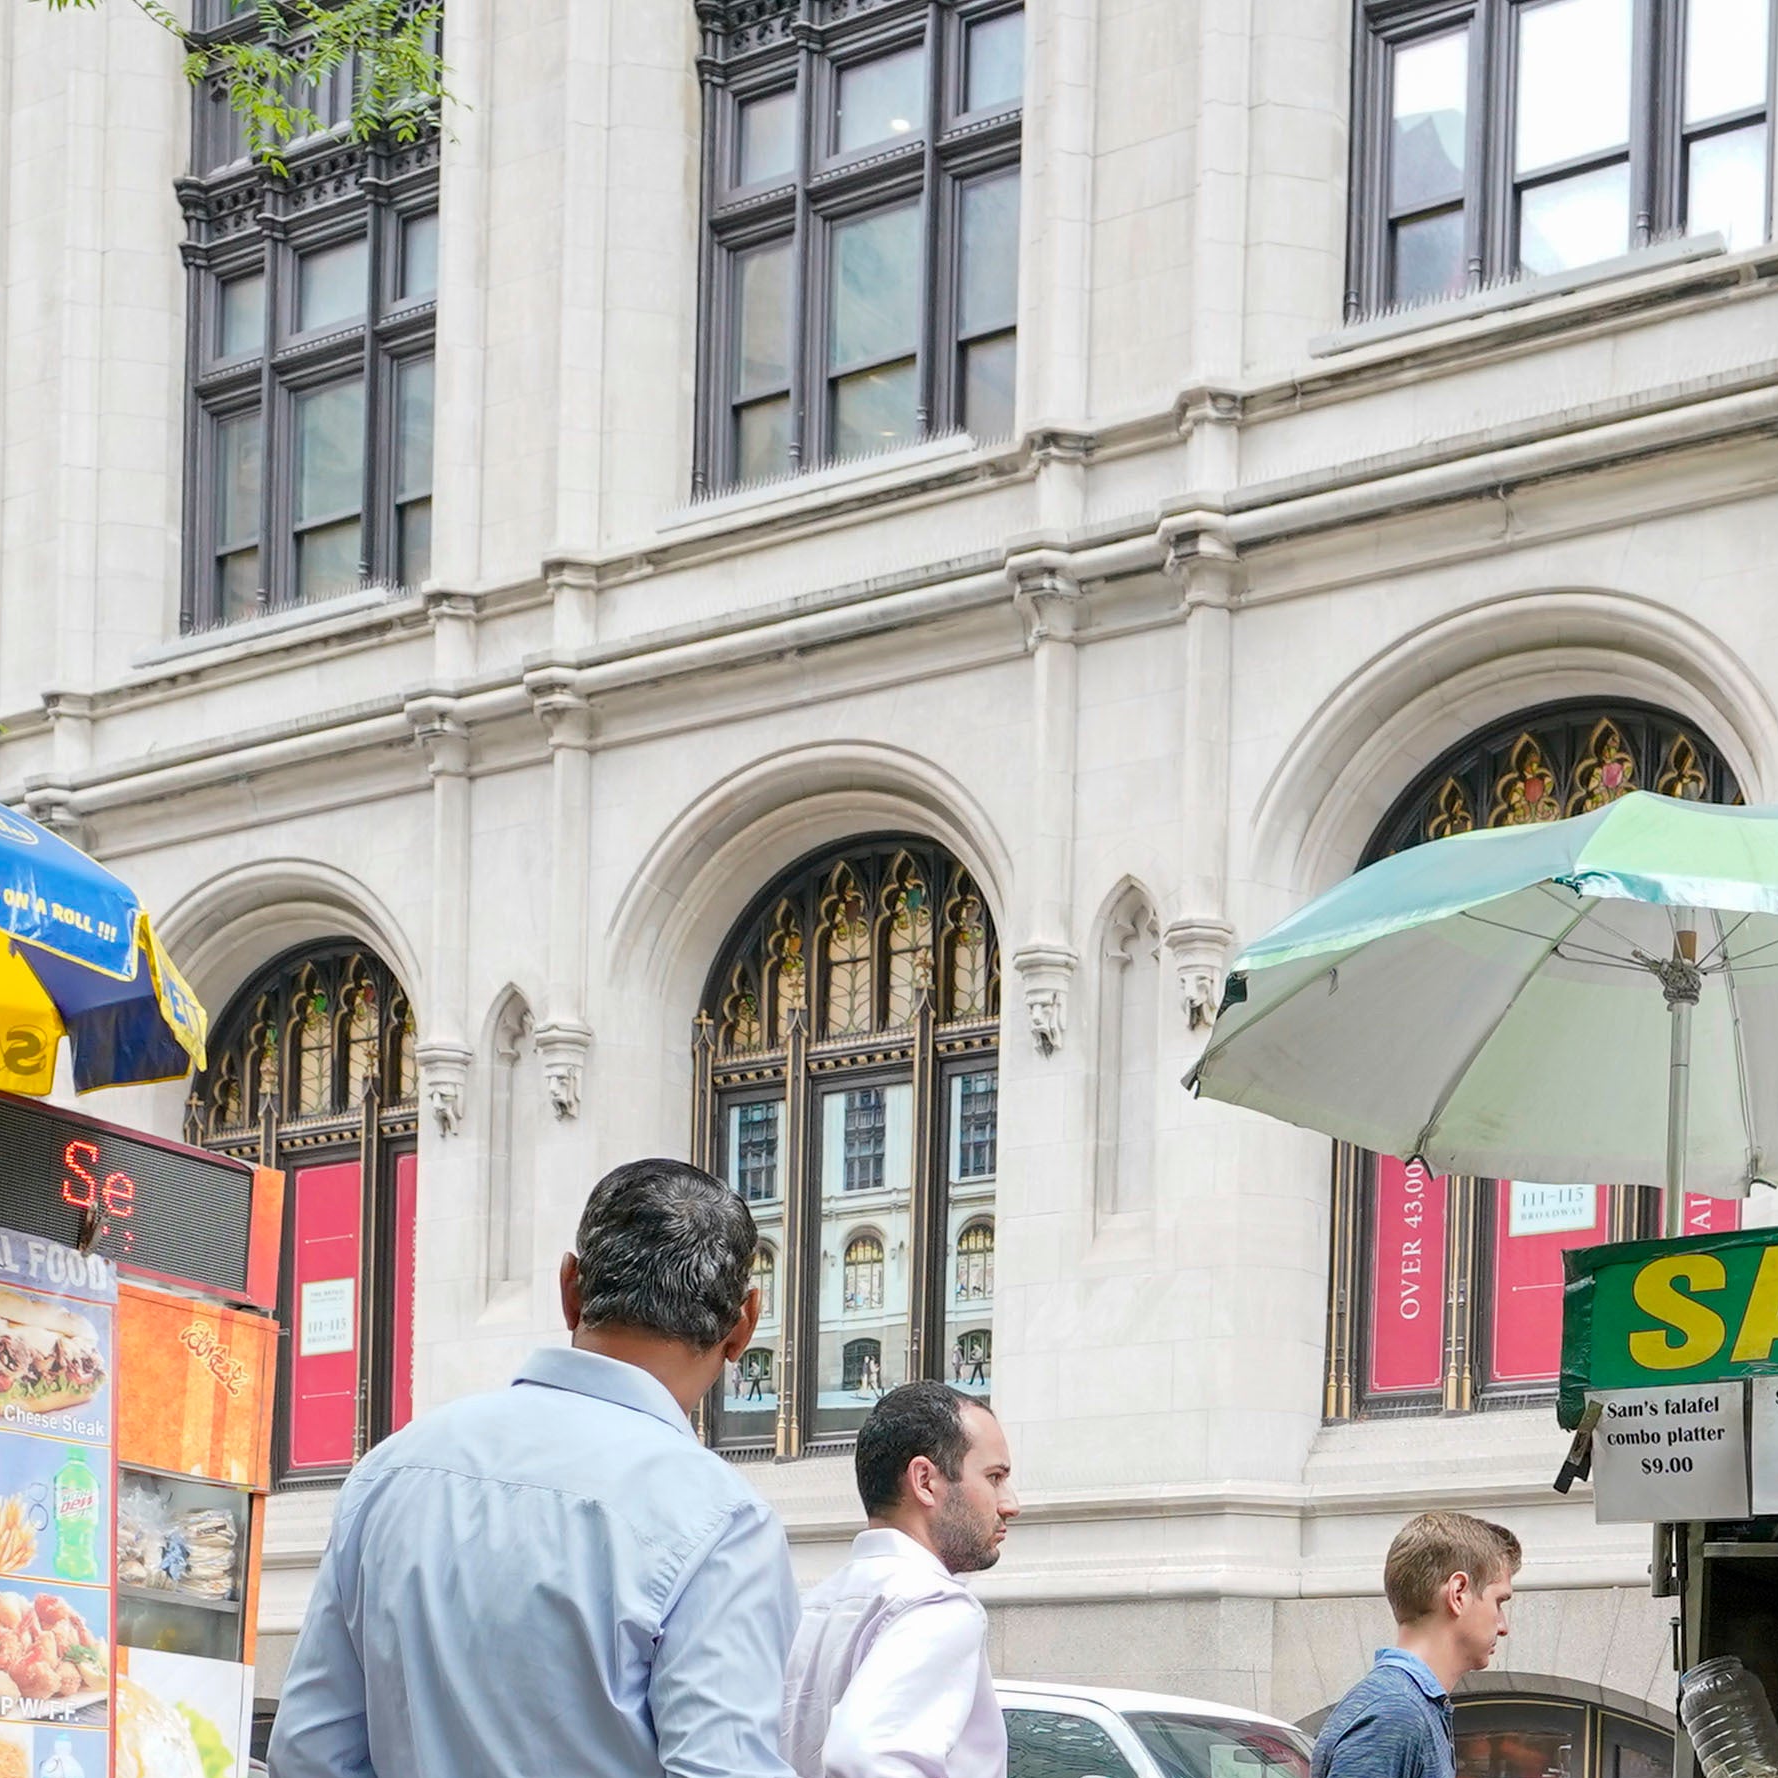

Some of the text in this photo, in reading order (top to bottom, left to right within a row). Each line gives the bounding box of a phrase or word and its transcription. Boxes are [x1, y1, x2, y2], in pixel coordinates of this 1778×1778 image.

[3, 889, 29, 911] ON
[32, 895, 47, 915] A
[52, 902, 94, 934] ROLL
[62, 1140, 135, 1218] Se
[1520, 1206, 1585, 1221] BROADWAY
[27, 1241, 108, 1291] FOOD
[1400, 1238, 1422, 1320] OVER
[4, 1401, 57, 1430] Cheese
[62, 1411, 105, 1437] Steak
[1606, 1396, 1720, 1419] Sam's falafel
[1607, 1426, 1726, 1448] combo platter
[1641, 1456, 1694, 1475] $9.00
[48, 1699, 80, 1722] F.F.
